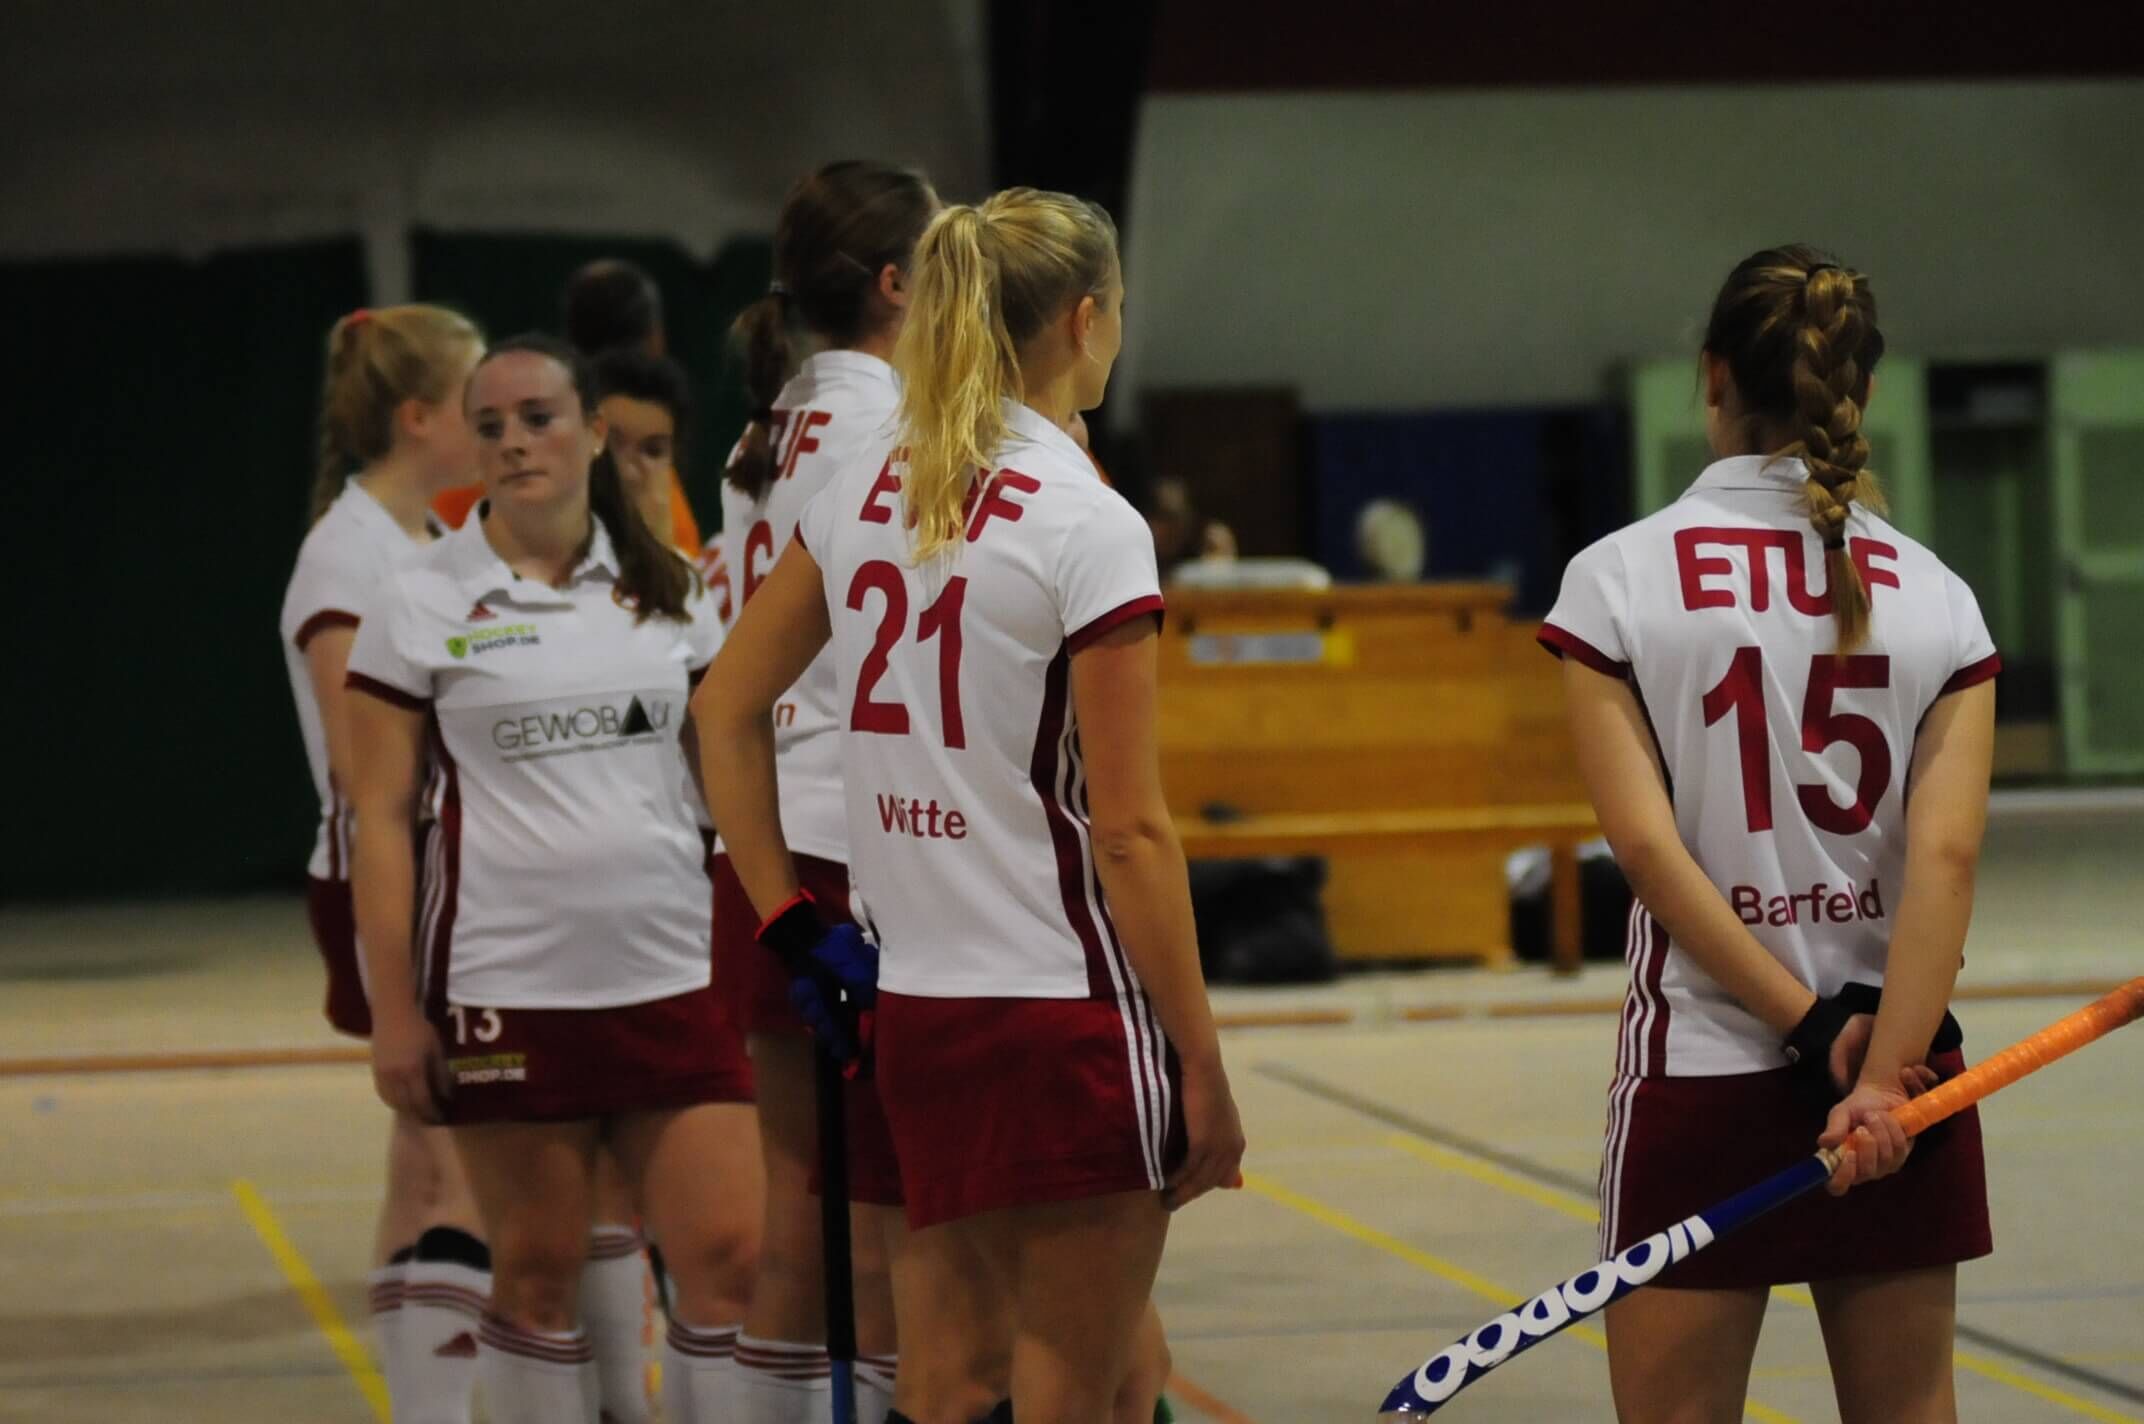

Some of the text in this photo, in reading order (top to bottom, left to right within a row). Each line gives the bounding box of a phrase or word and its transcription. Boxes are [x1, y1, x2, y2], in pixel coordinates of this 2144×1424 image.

[859, 446, 1041, 542] EF
[1674, 527, 1900, 616] ETUF
[846, 560, 968, 750] 21
[492, 694, 670, 750] GEWOBAU
[1702, 646, 1891, 835] 15
[877, 793, 967, 839] Witte
[1731, 879, 1884, 927] Barfeld
[1415, 1215, 1714, 1401] VOODOO
